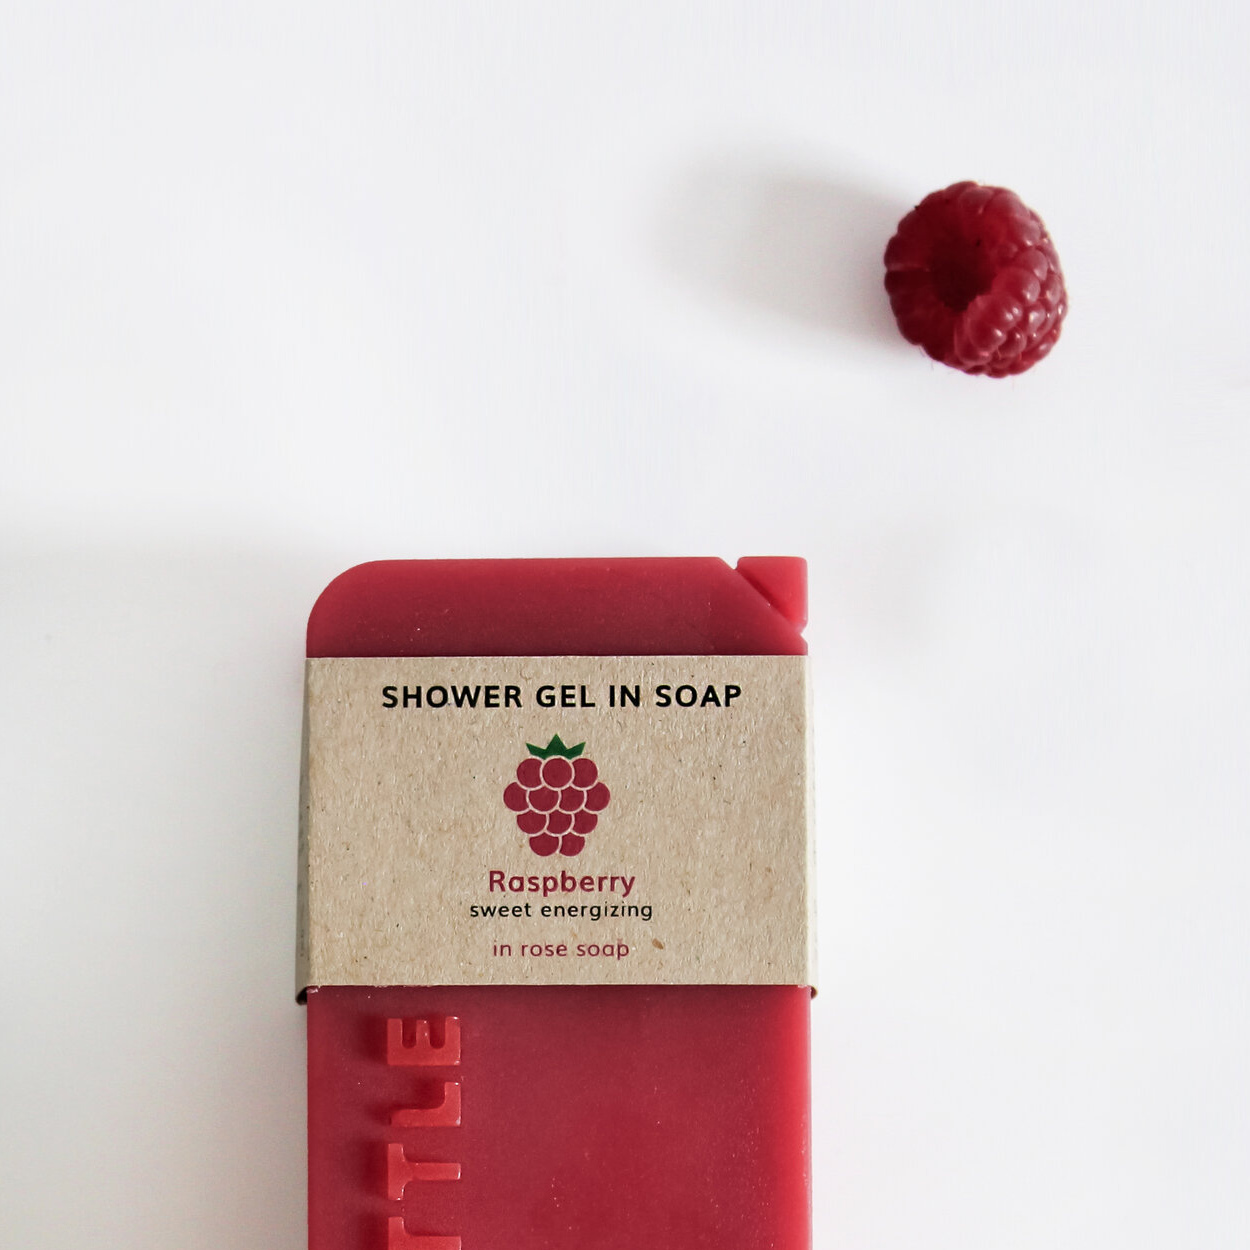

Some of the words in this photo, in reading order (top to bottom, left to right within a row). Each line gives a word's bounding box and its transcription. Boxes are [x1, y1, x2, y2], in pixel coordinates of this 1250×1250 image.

[382, 684, 522, 709] SHOWER
[535, 684, 596, 708] GEL
[609, 684, 641, 708] IN
[655, 684, 742, 708] SOAP
[489, 869, 636, 898] Raspberry
[469, 902, 532, 918] sweet
[540, 902, 653, 922] energizing
[493, 939, 513, 957] in
[521, 943, 568, 957] rose
[576, 943, 630, 960] soap
